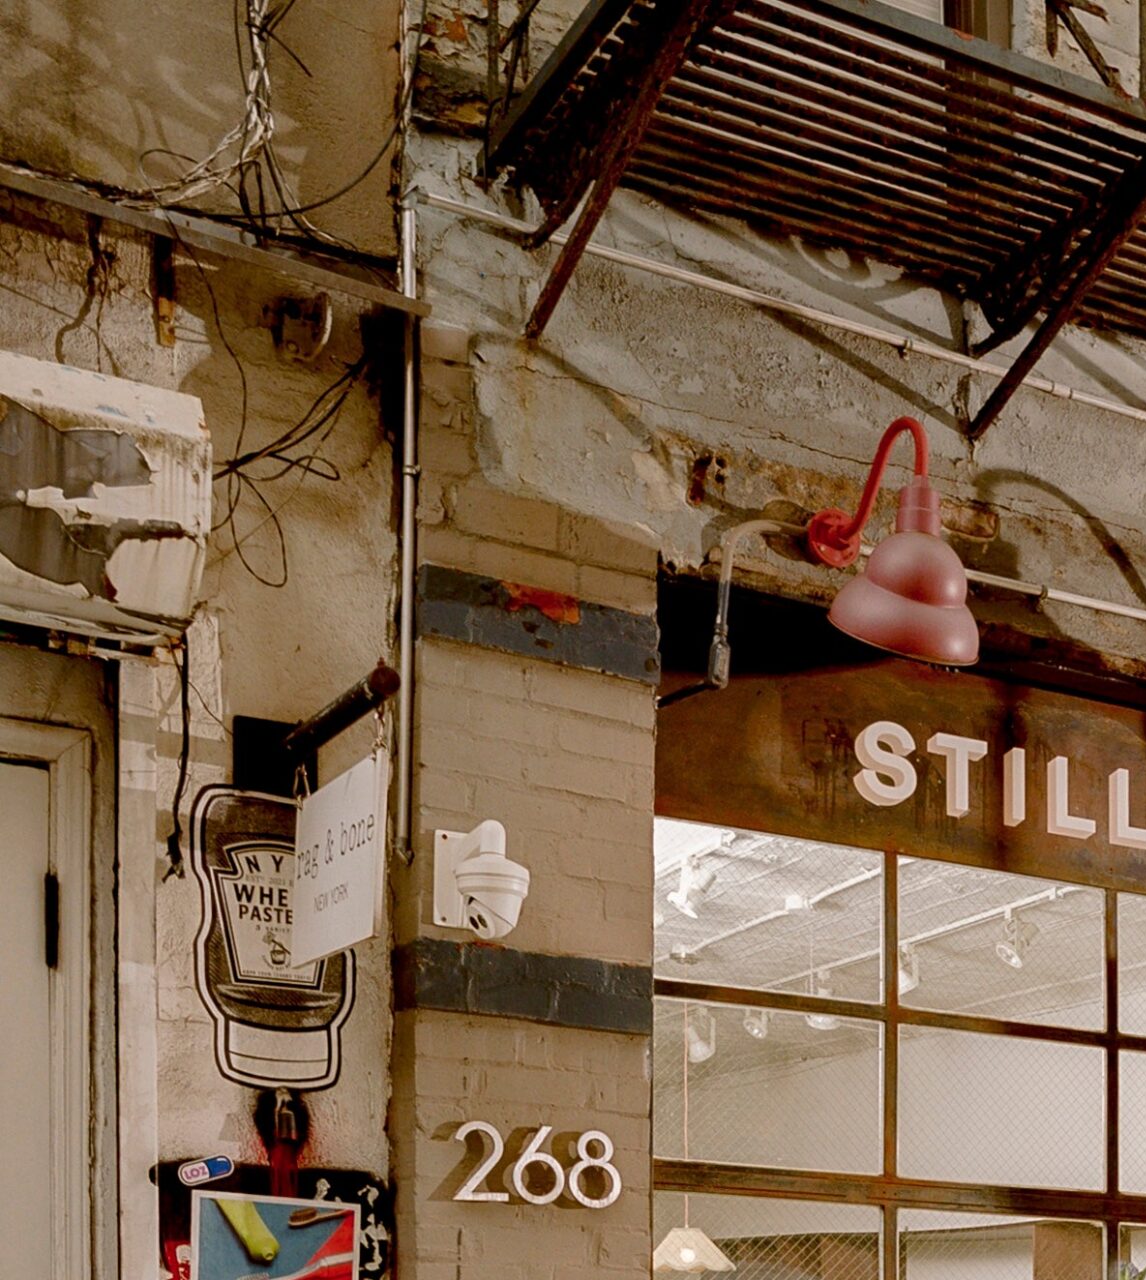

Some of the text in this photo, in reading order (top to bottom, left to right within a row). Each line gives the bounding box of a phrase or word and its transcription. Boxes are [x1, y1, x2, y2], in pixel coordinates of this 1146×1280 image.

[297, 813, 375, 879] rag & bone
[245, 854, 285, 874] NY
[233, 882, 290, 908] WHE
[238, 903, 294, 926] PASTE
[452, 1120, 623, 1210] 268
